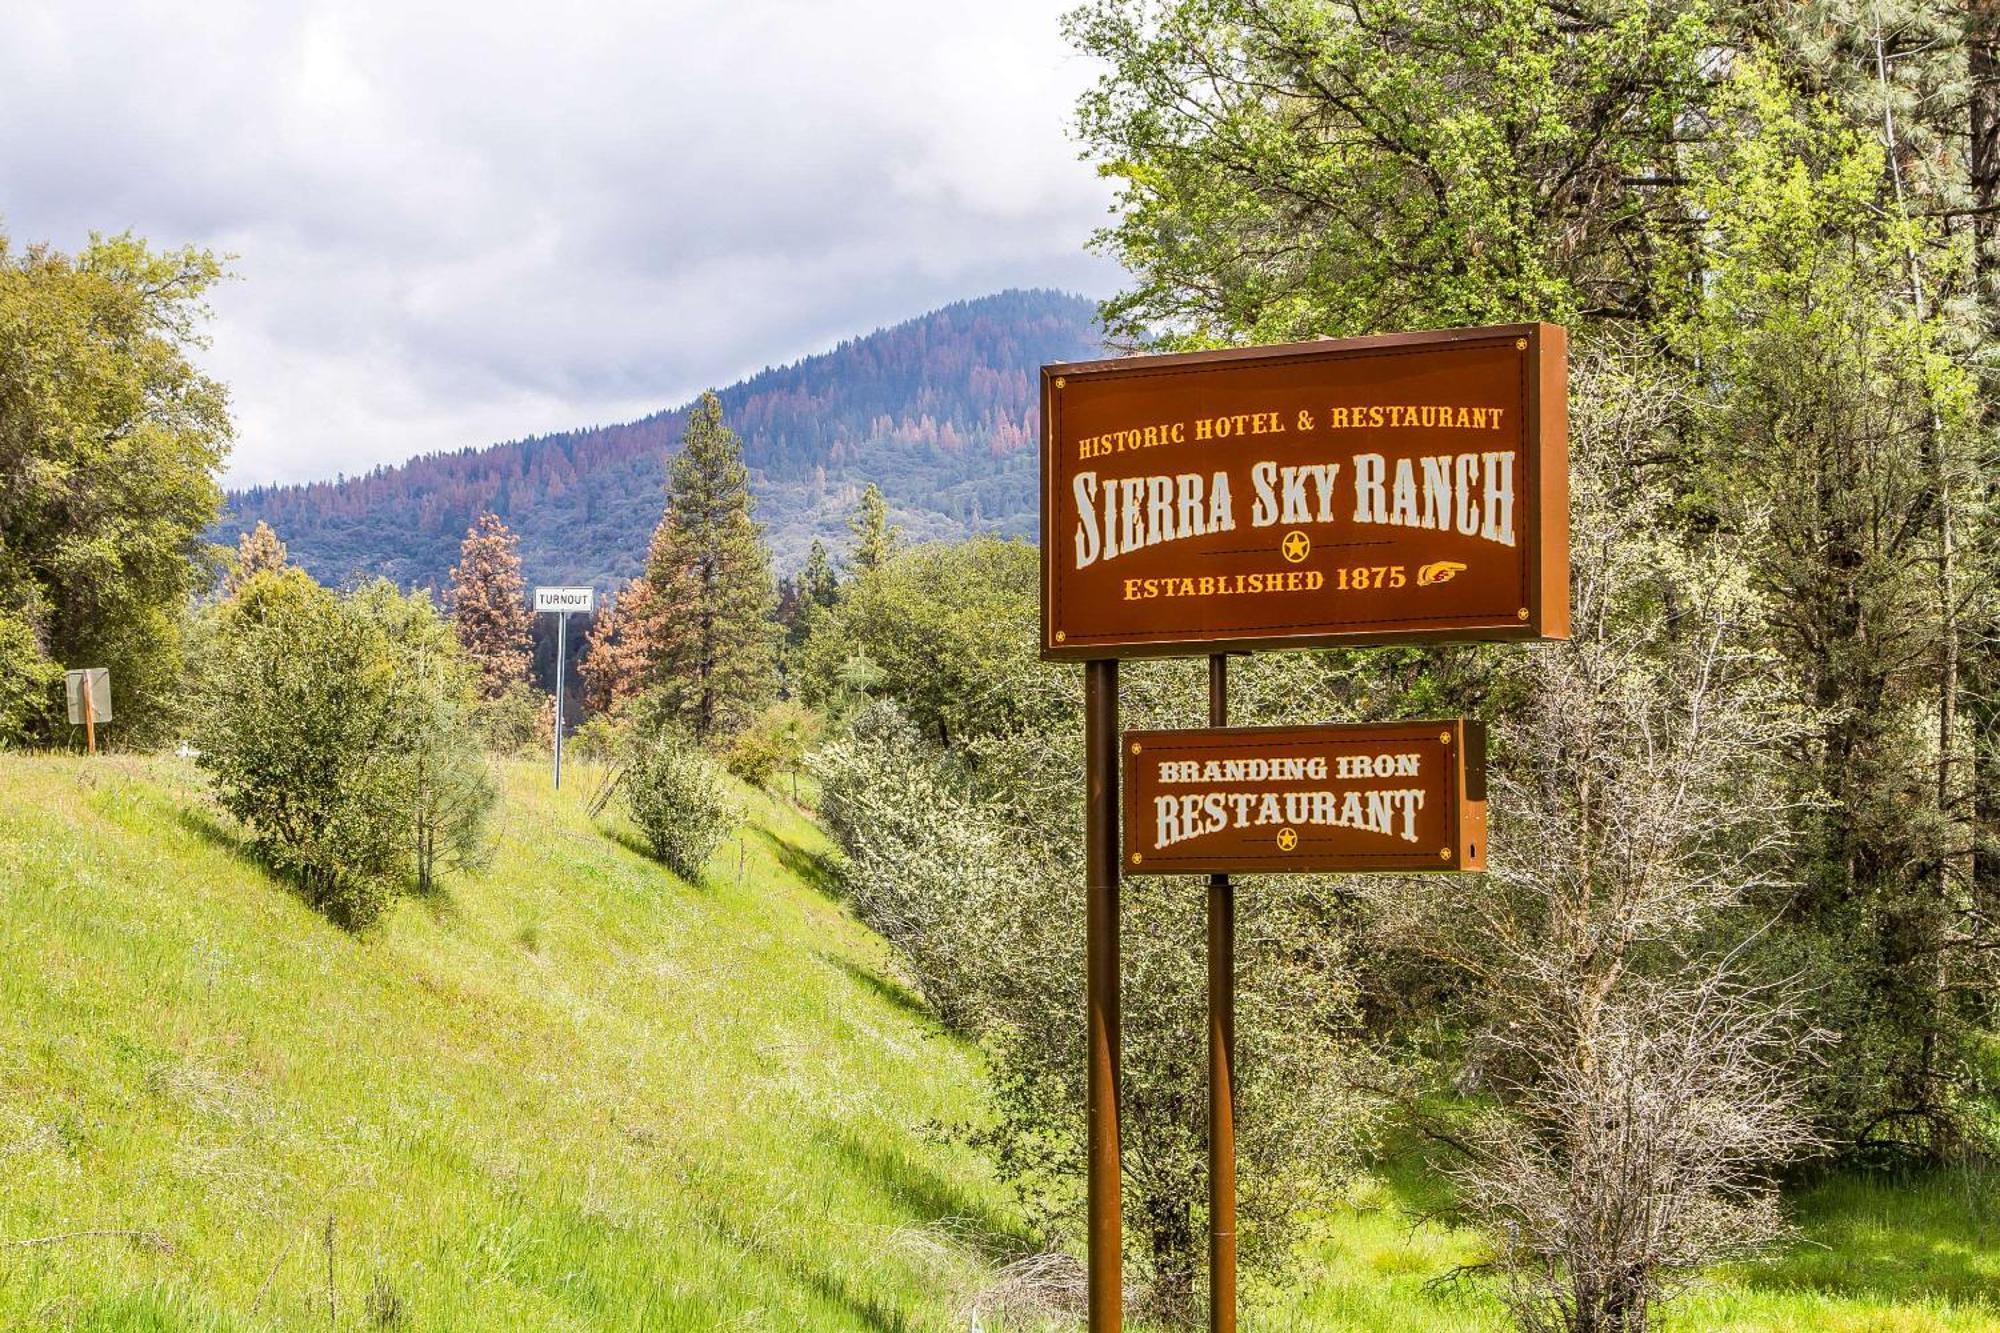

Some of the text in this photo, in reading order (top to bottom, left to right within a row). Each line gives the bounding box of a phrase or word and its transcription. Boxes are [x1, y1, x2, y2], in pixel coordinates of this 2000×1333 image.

[1079, 405, 1503, 460] HISTORIC HOTEL & RESTAURANT
[1073, 451, 1516, 570] SIERRA SKY RANCH
[539, 594, 588, 605] TURNOUT
[1123, 566, 1406, 601] ESTABLISHED 1875
[1158, 754, 1421, 783] BRANDING IRON
[1154, 789, 1426, 850] RESTAURANT
